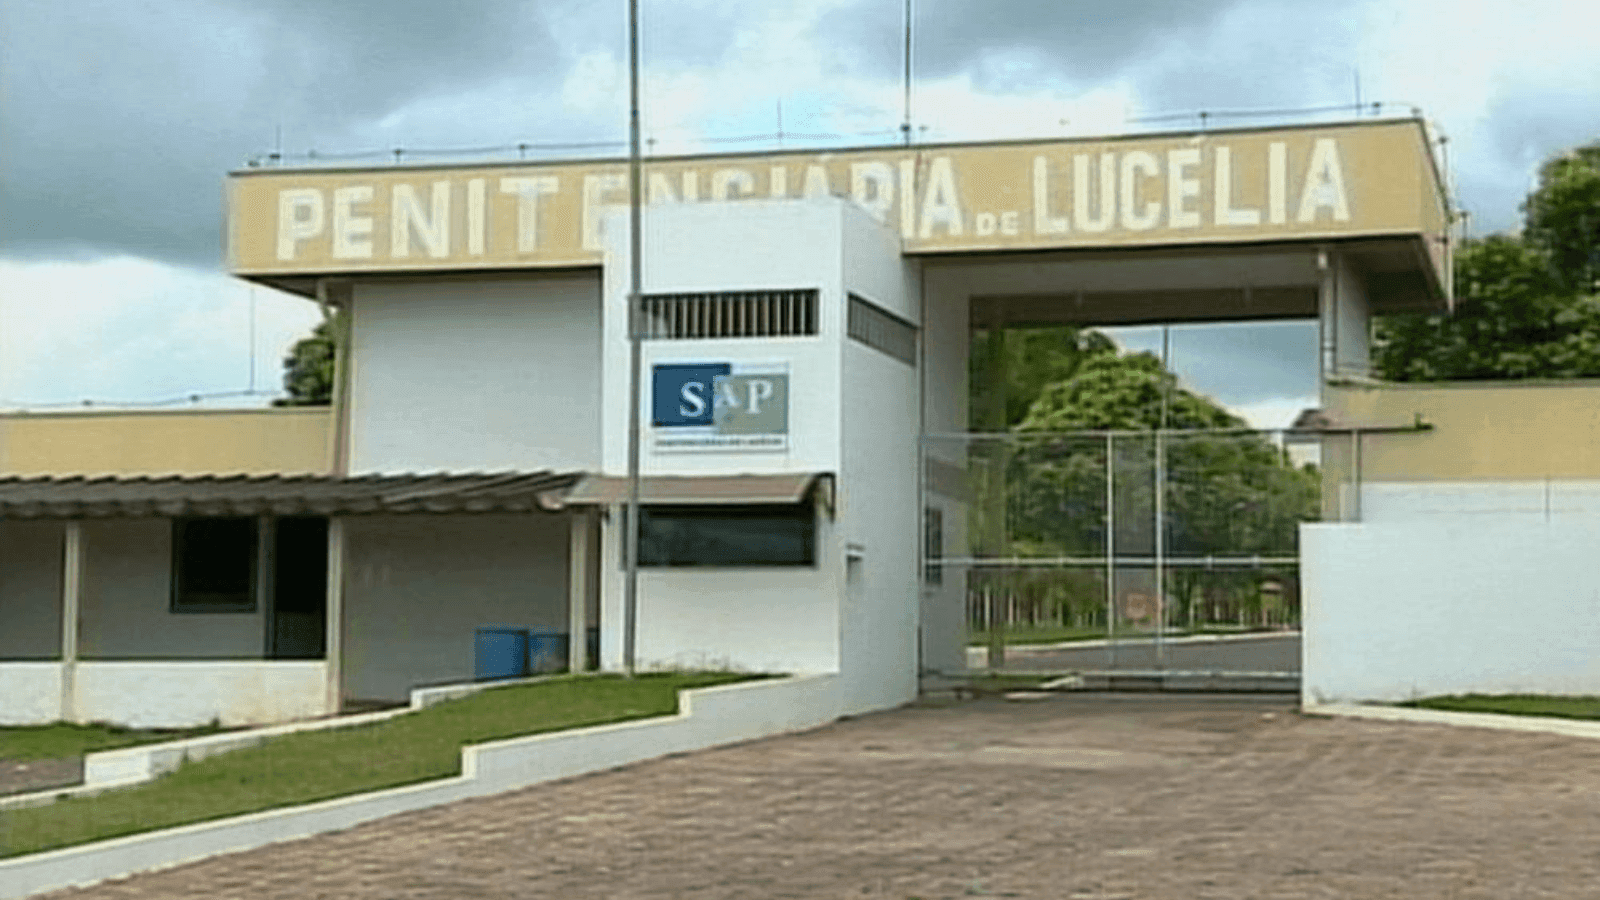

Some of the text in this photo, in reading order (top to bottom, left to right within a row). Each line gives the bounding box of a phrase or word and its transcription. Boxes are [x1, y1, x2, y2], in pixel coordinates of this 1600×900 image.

[975, 210, 1019, 236] DE
[1033, 135, 1350, 235] LUCÉLIA
[679, 379, 774, 417] SAP
